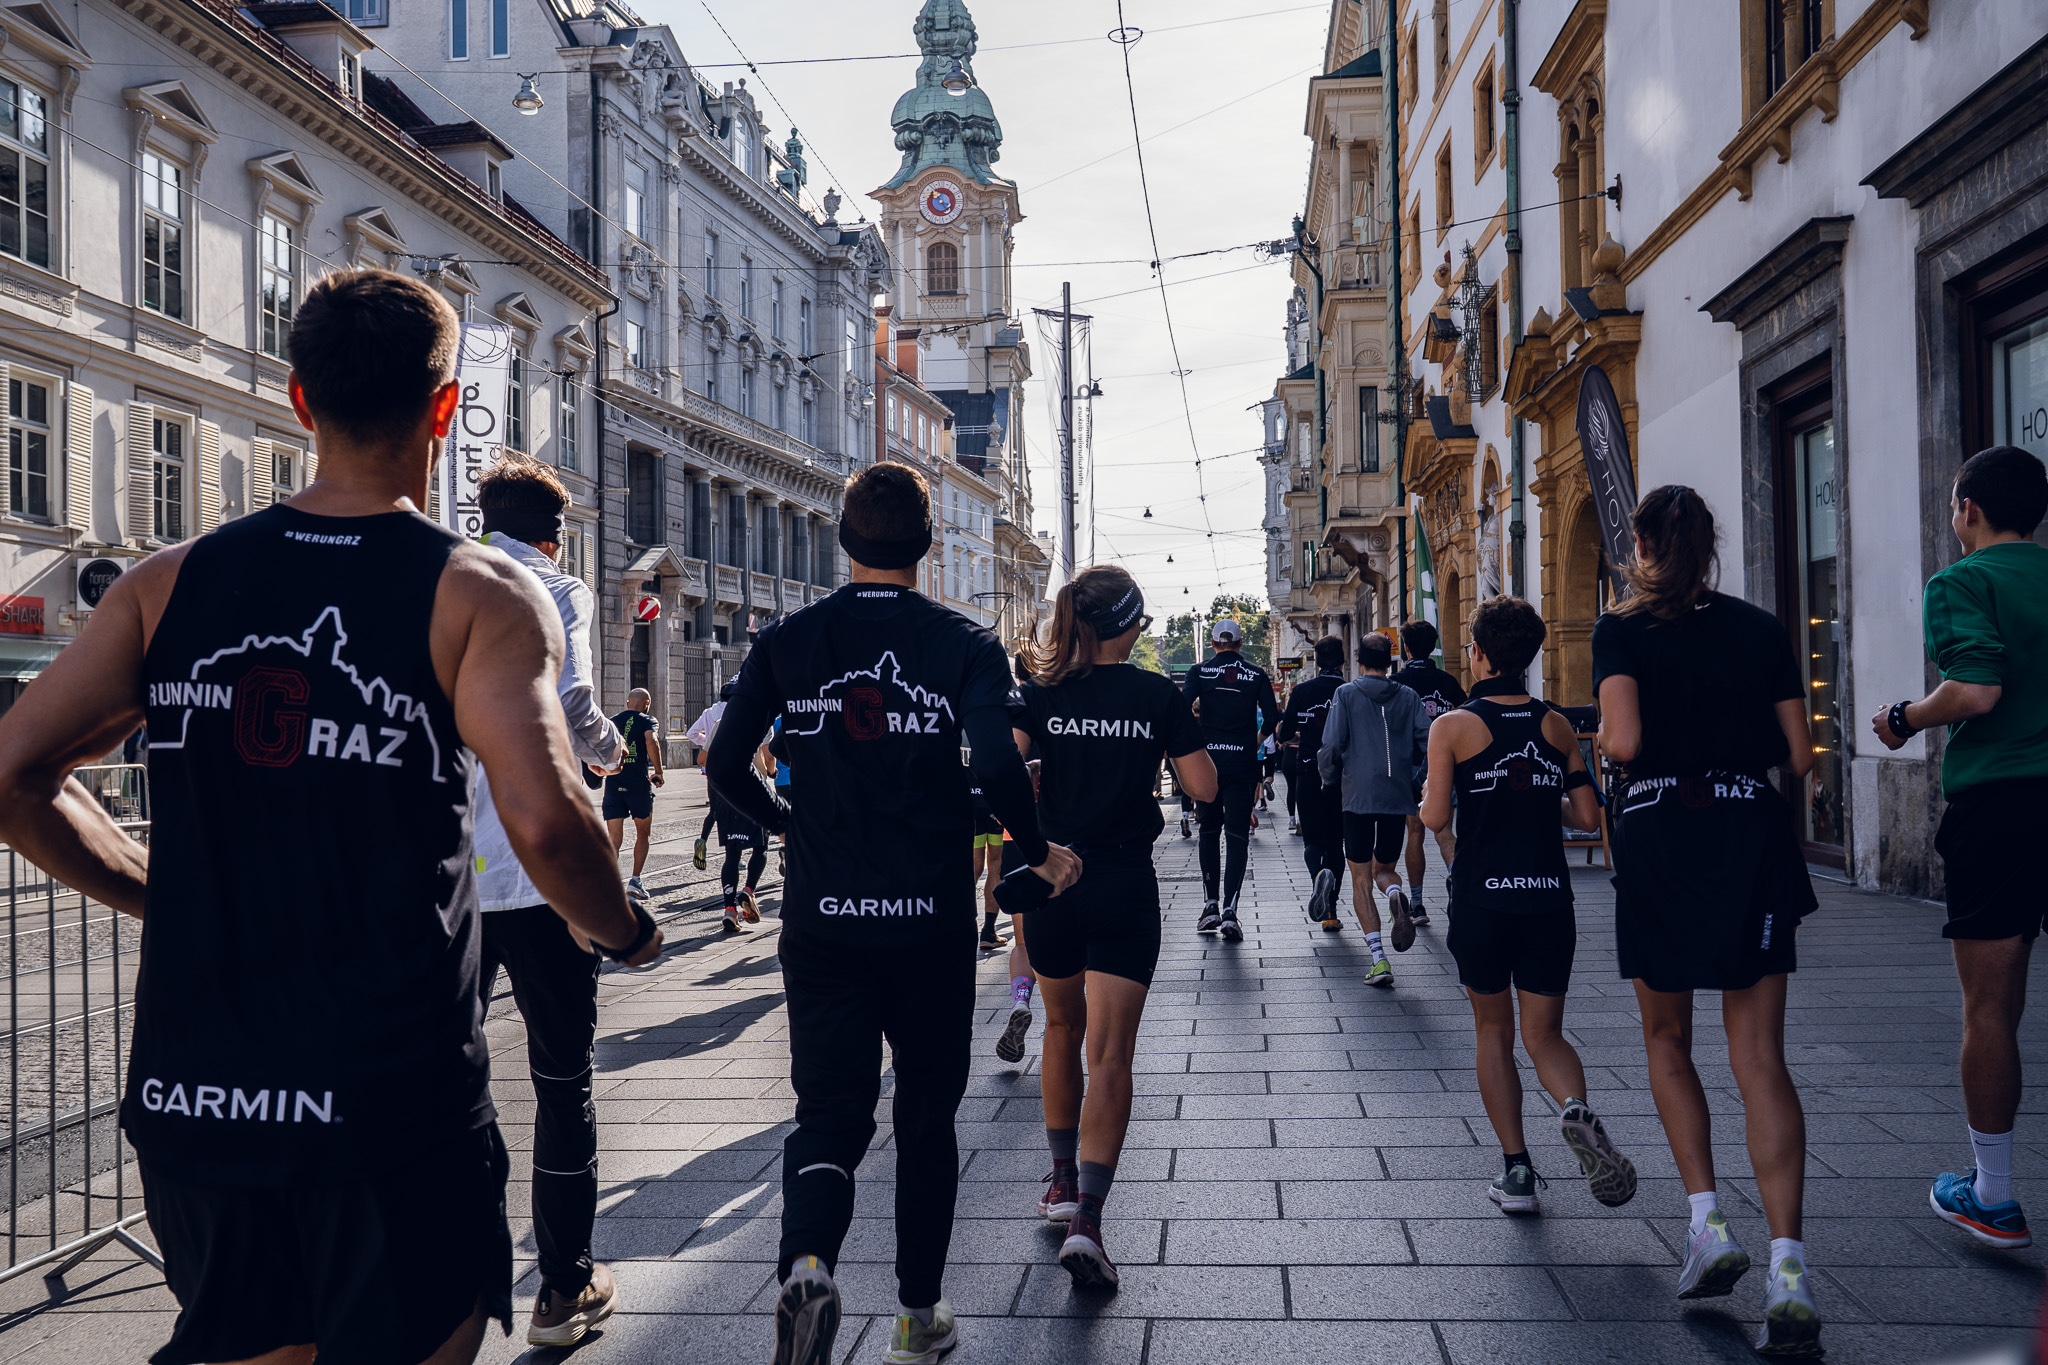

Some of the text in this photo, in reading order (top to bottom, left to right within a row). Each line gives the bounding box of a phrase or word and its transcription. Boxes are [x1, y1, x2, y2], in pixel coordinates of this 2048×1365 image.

[450, 441, 458, 496] interkultureller
[459, 443, 483, 484] art
[284, 530, 362, 546] #WERUNGRZ
[857, 589, 899, 598] #WERUNGRZ
[1047, 716, 1152, 740] GARMIN
[1206, 743, 1244, 751] GARMIN
[1485, 876, 1560, 890] GARMIN
[819, 896, 934, 917] GARMIN
[142, 1077, 334, 1123] GARMIN
